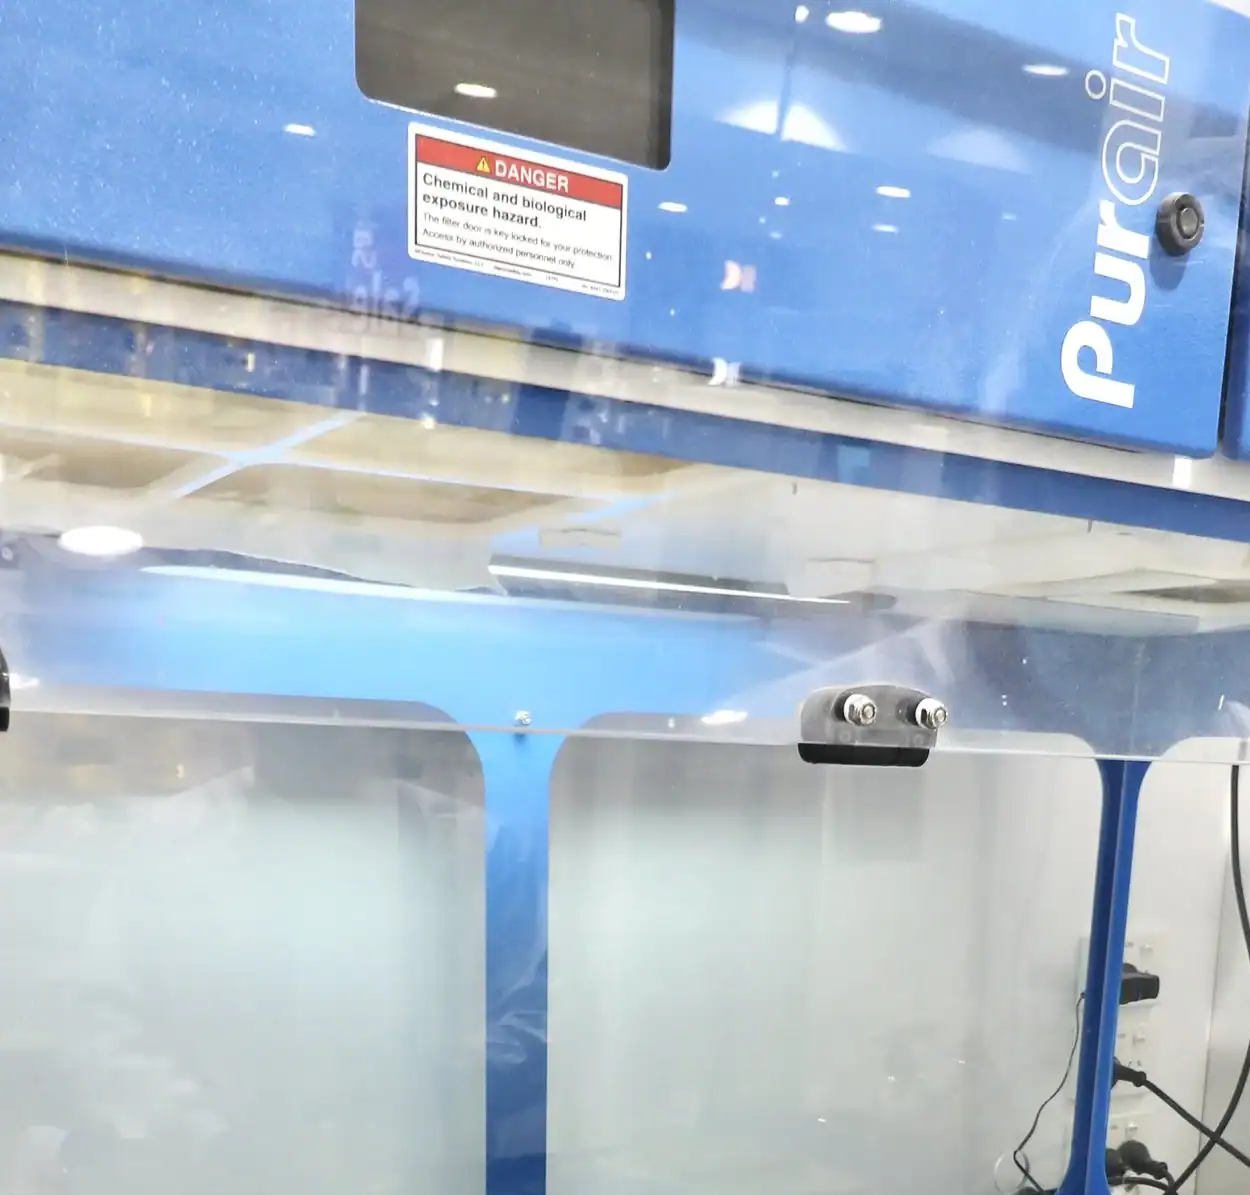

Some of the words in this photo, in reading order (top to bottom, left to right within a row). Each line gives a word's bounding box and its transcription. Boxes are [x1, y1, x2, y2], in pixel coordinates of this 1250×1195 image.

[495, 159, 569, 193] DANGER
[422, 193, 489, 217] exposure
[492, 205, 542, 229] hazard.
[423, 172, 488, 199] Chemical
[492, 190, 518, 206] and
[521, 195, 586, 222] biological
[1060, 12, 1170, 408] Purair
[422, 227, 454, 242] Access
[456, 233, 468, 247] by
[469, 238, 514, 256] authorized
[515, 249, 557, 264] personnel
[423, 211, 440, 224] The
[442, 215, 461, 229] filter
[463, 221, 482, 234] door
[493, 228, 509, 241] key
[511, 231, 539, 246] locked
[540, 238, 551, 248] for
[553, 242, 571, 254] your
